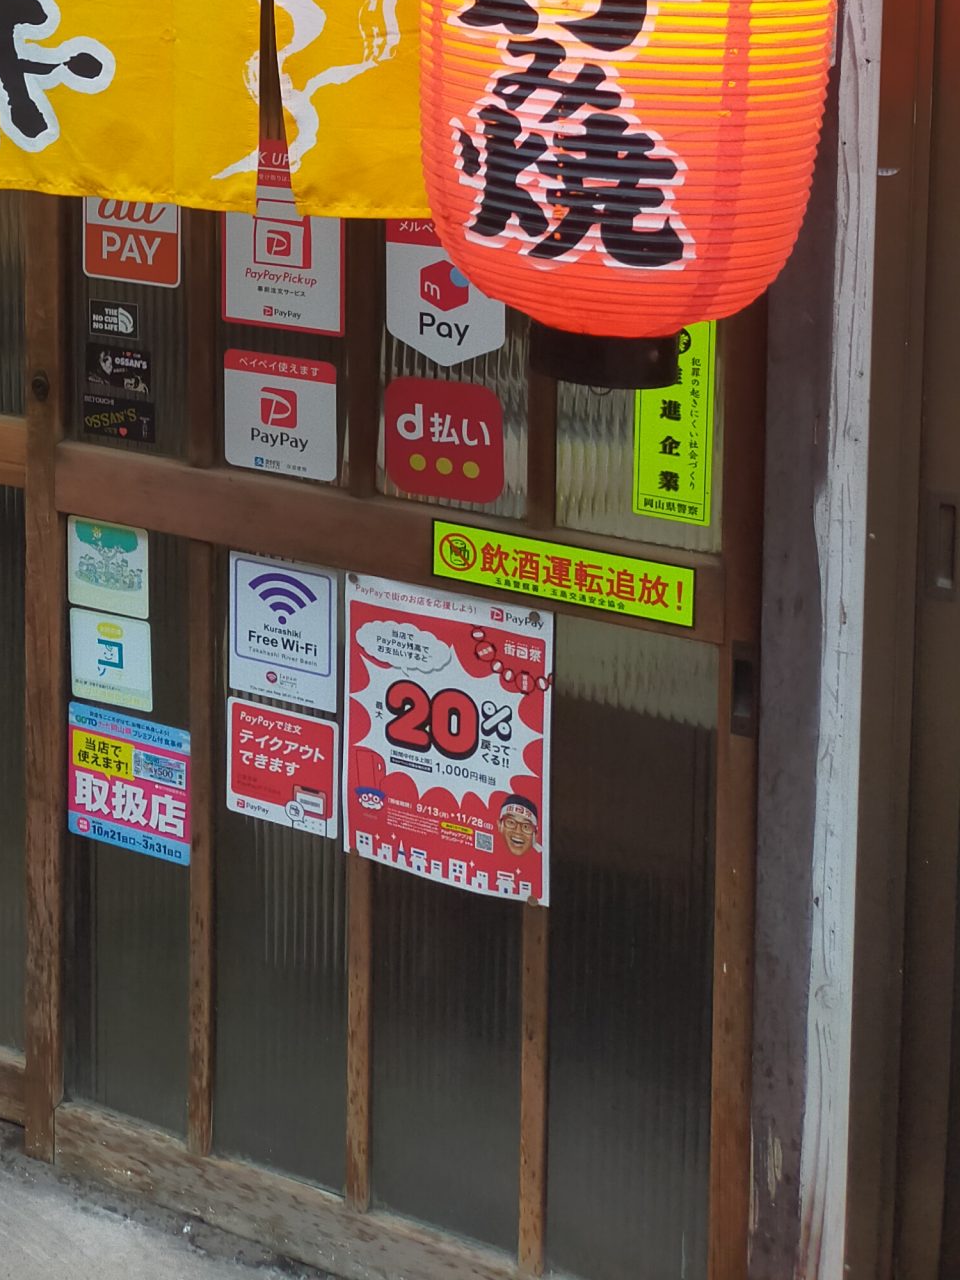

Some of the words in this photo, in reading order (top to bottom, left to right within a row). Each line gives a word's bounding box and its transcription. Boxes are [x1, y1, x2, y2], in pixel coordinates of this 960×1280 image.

[398, 220, 436, 234] メルペ
[102, 230, 161, 265] PAY
[418, 312, 469, 346] Pay
[396, 403, 491, 446] d払い
[250, 427, 308, 452] PayPay
[643, 497, 699, 516] 岡山県警察
[480, 542, 683, 612] 飲酒運転追放!
[248, 629, 278, 647] Free
[281, 637, 318, 657] Wi-Fi
[263, 623, 301, 639] Kurashiki
[391, 629, 415, 641] 当店で
[240, 711, 302, 735] PayPayで注文
[85, 737, 122, 758] 当店で
[239, 729, 325, 763] テイクアウト
[78, 748, 129, 775] 使えます!
[239, 749, 300, 777] できます
[435, 762, 497, 786] 1,000円相当
[75, 769, 186, 838] 取扱店
